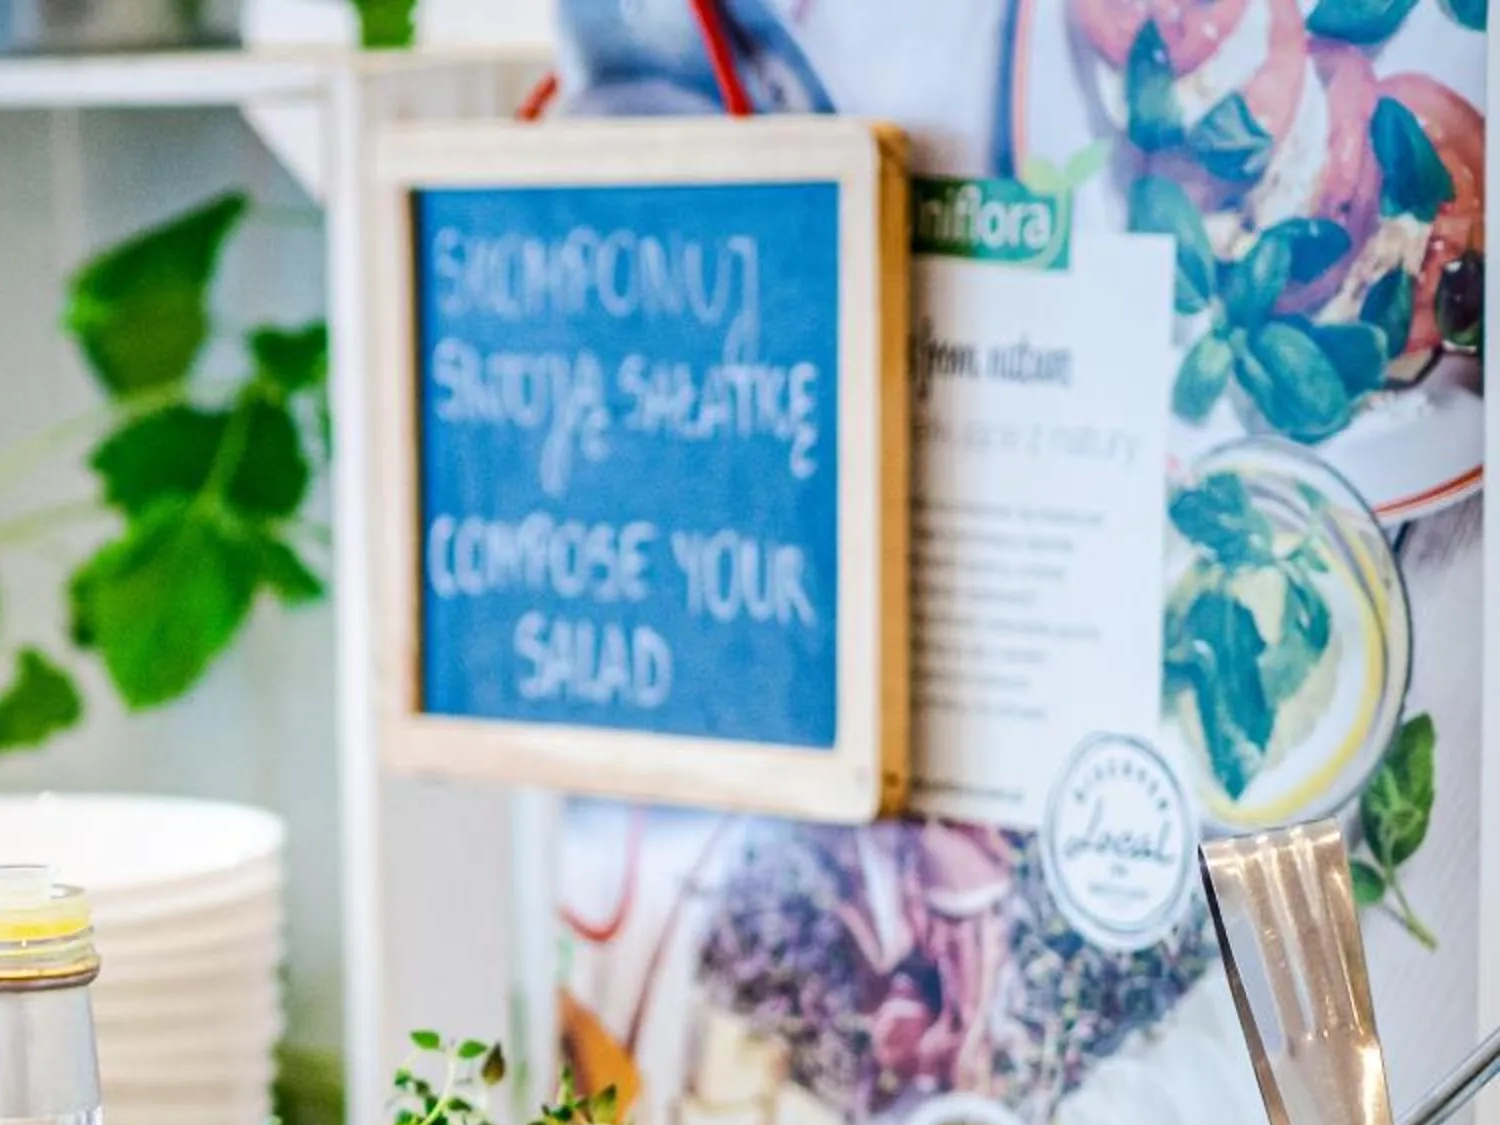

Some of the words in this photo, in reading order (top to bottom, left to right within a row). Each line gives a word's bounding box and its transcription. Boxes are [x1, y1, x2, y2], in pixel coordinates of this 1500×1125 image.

[433, 226, 759, 362] SKOMPONUJ
[427, 511, 658, 601] COMPOSE
[671, 530, 818, 626] YOUR
[513, 609, 673, 709] SALAD
[1063, 793, 1179, 865] Local
